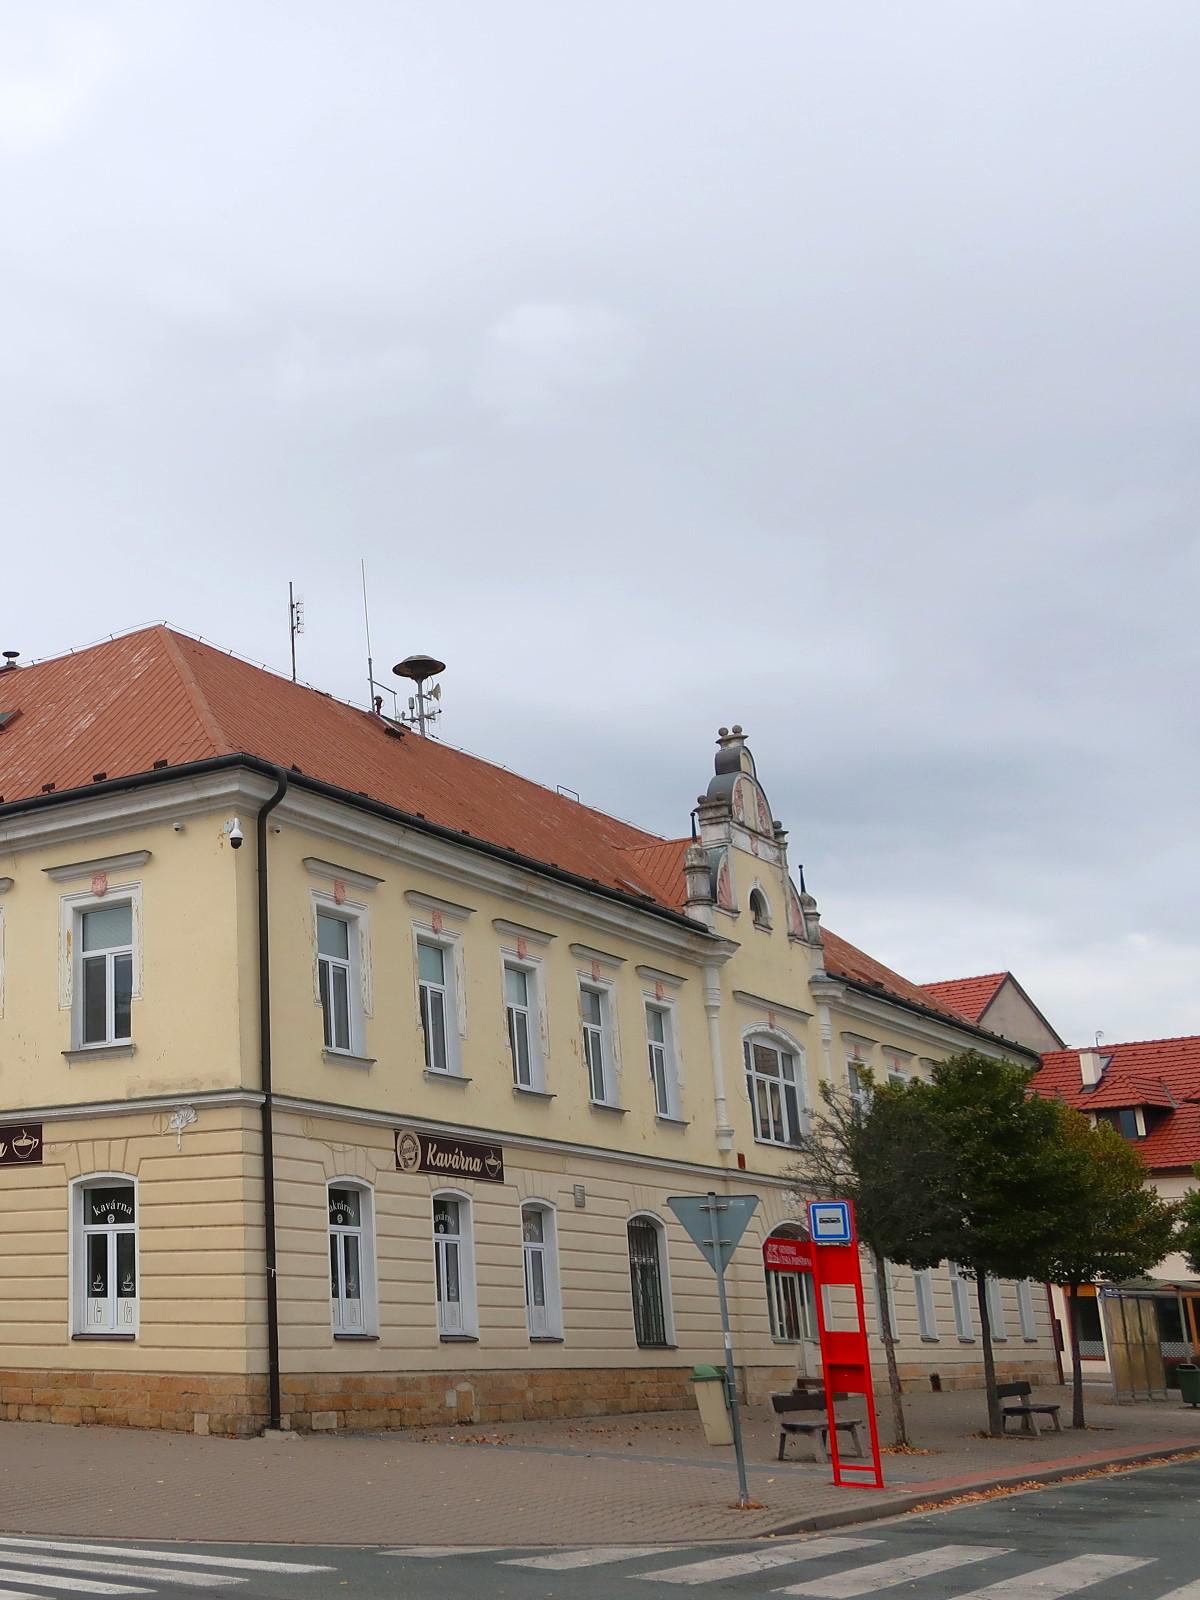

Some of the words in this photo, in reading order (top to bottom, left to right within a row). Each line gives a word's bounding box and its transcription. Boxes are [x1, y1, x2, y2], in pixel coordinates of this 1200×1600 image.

[426, 1142, 483, 1173] Kavárna
[92, 1199, 133, 1216] kavárna
[329, 1199, 355, 1218] ukrárna
